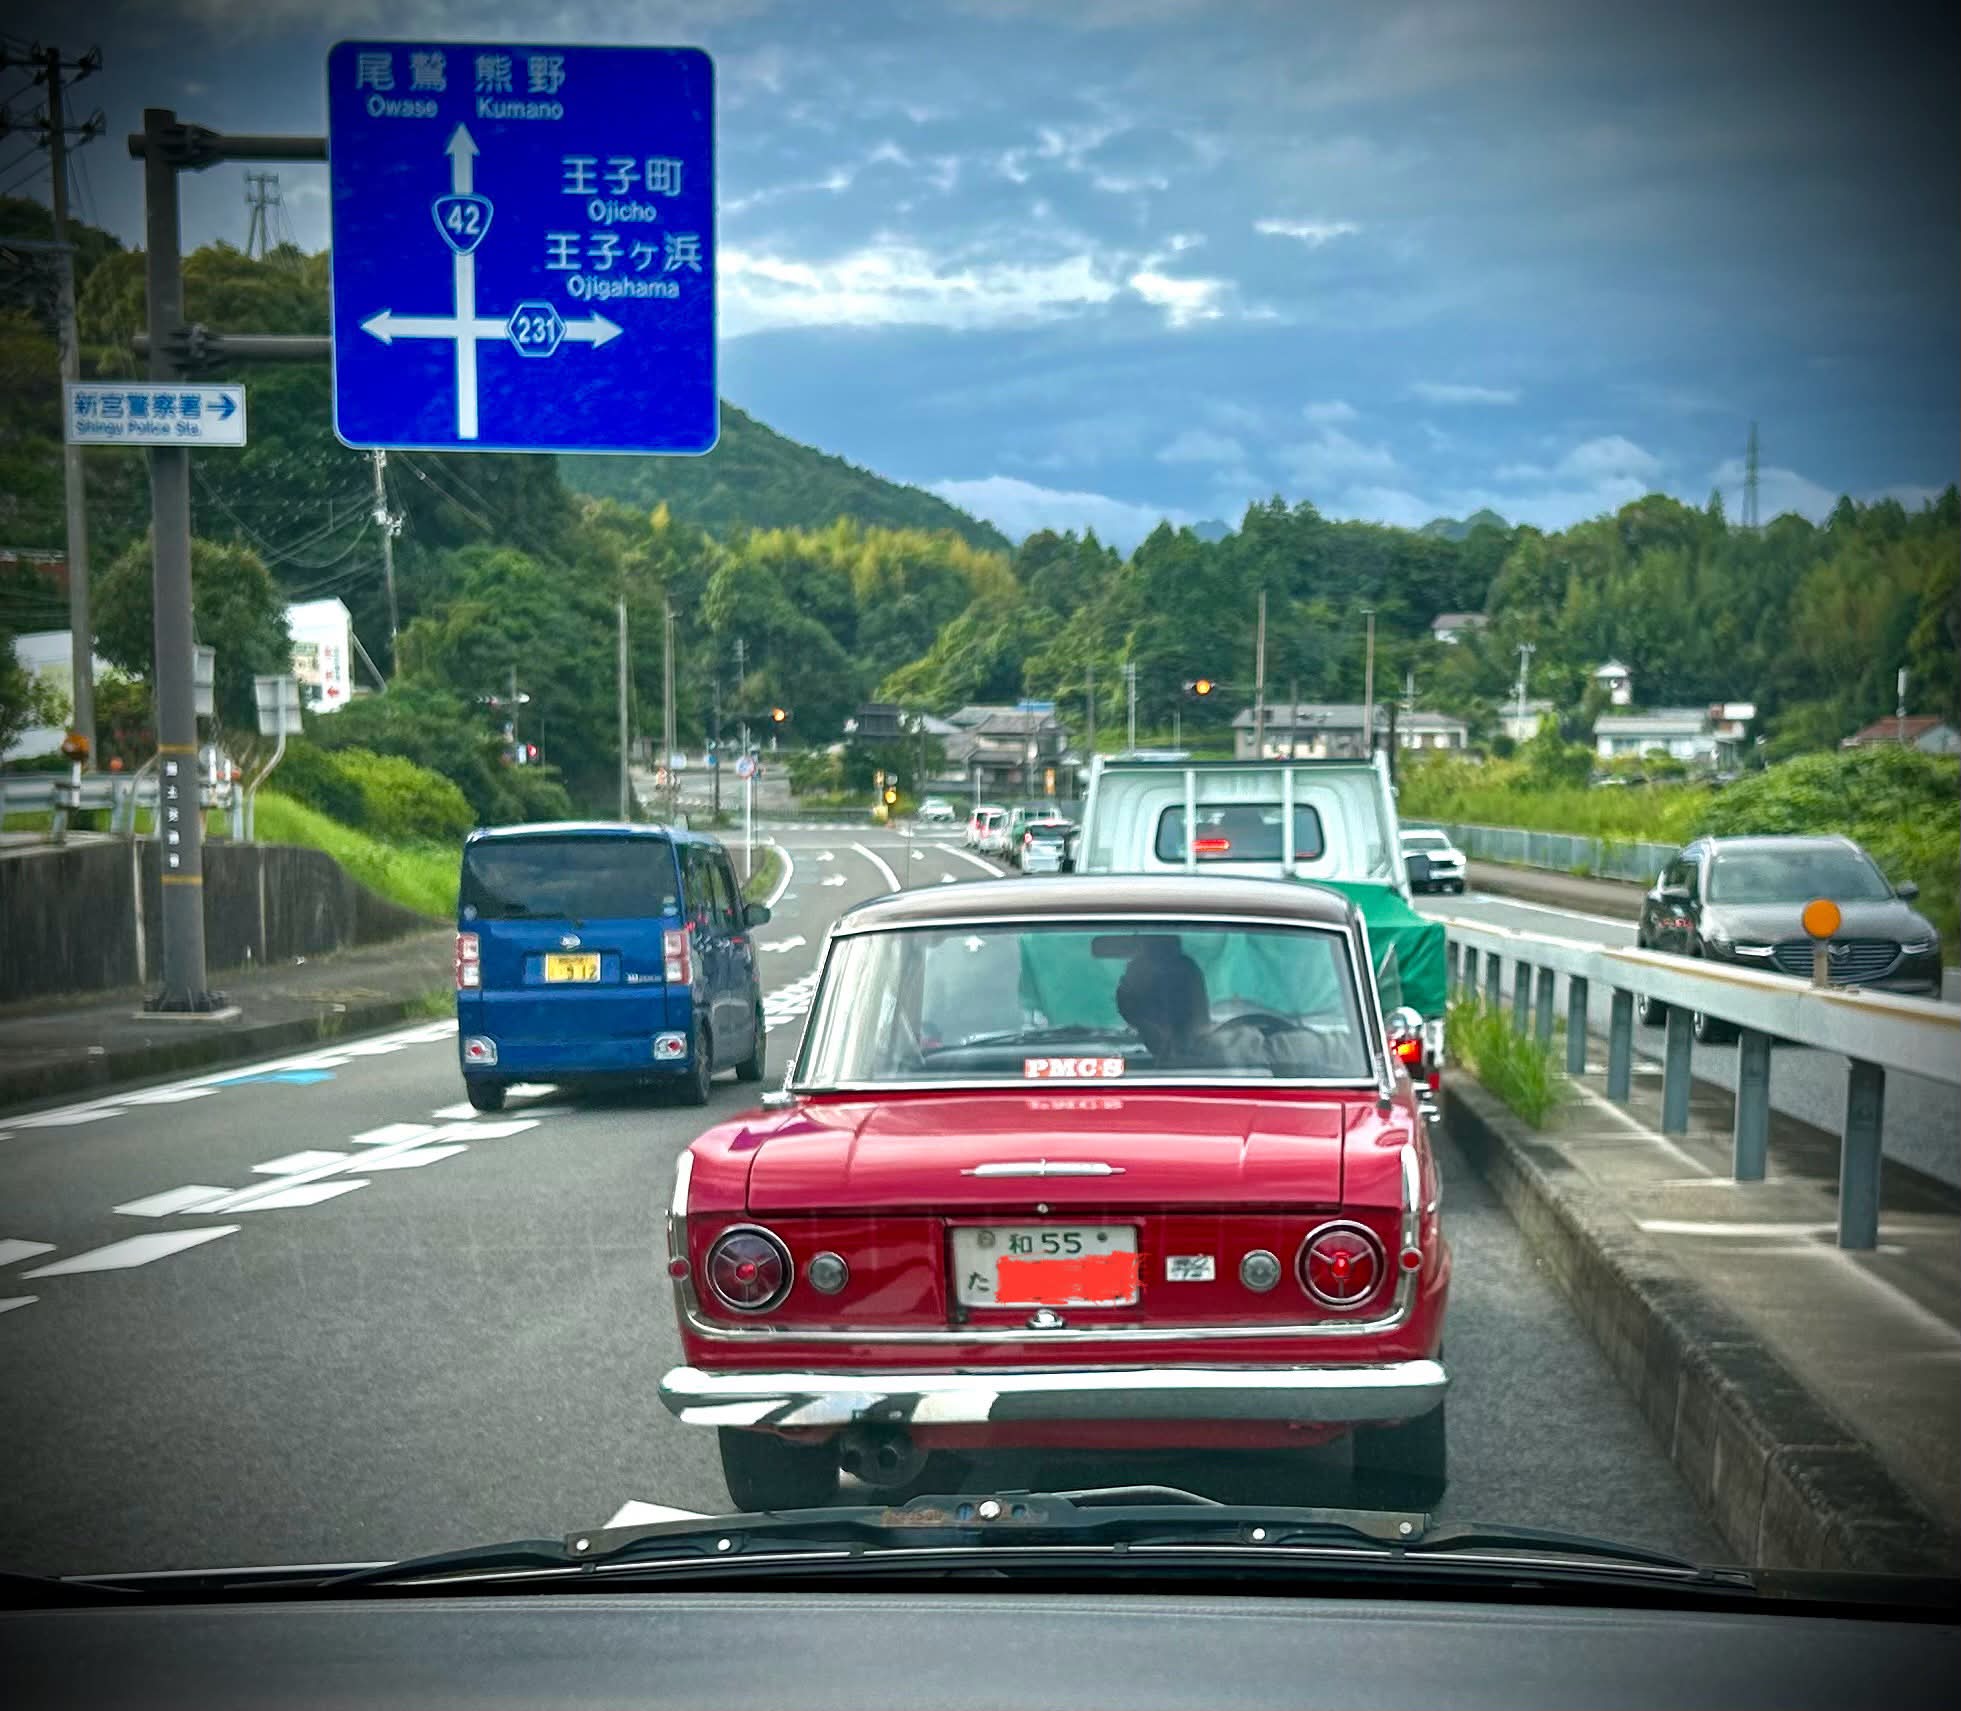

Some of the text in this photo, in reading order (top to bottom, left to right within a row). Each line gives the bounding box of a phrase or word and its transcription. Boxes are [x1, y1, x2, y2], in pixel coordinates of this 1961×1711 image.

[356, 52, 447, 91] 尾鷲
[475, 55, 566, 94] 熊野
[367, 94, 438, 117] Owase
[477, 96, 564, 119] Kumano
[561, 157, 684, 196] 王子町
[447, 204, 481, 235] 42
[588, 199, 657, 225] Ojicho
[567, 274, 680, 300] Ojigahama
[517, 316, 556, 344] 231
[1041, 1232, 1082, 1254] 55
